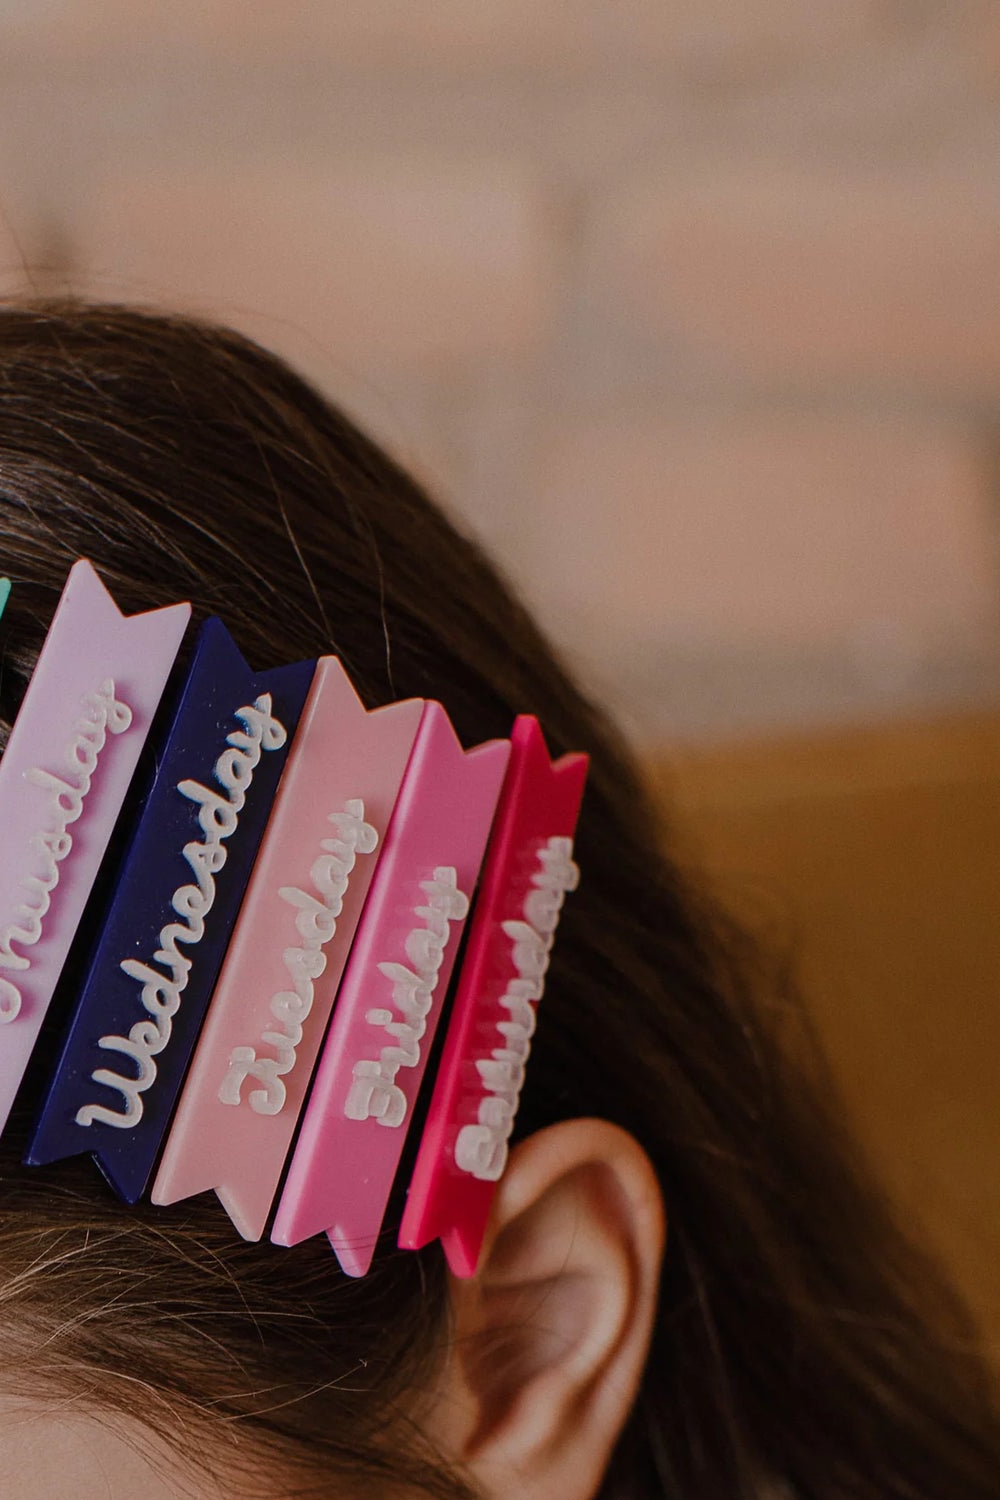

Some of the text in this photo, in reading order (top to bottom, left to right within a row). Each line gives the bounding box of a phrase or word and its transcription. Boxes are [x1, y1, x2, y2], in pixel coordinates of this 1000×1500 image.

[75, 692, 288, 1129] Wednesday
[218, 797, 379, 1116] Tuesday
[344, 865, 470, 1128] Friday
[454, 836, 581, 1182] Saturday
